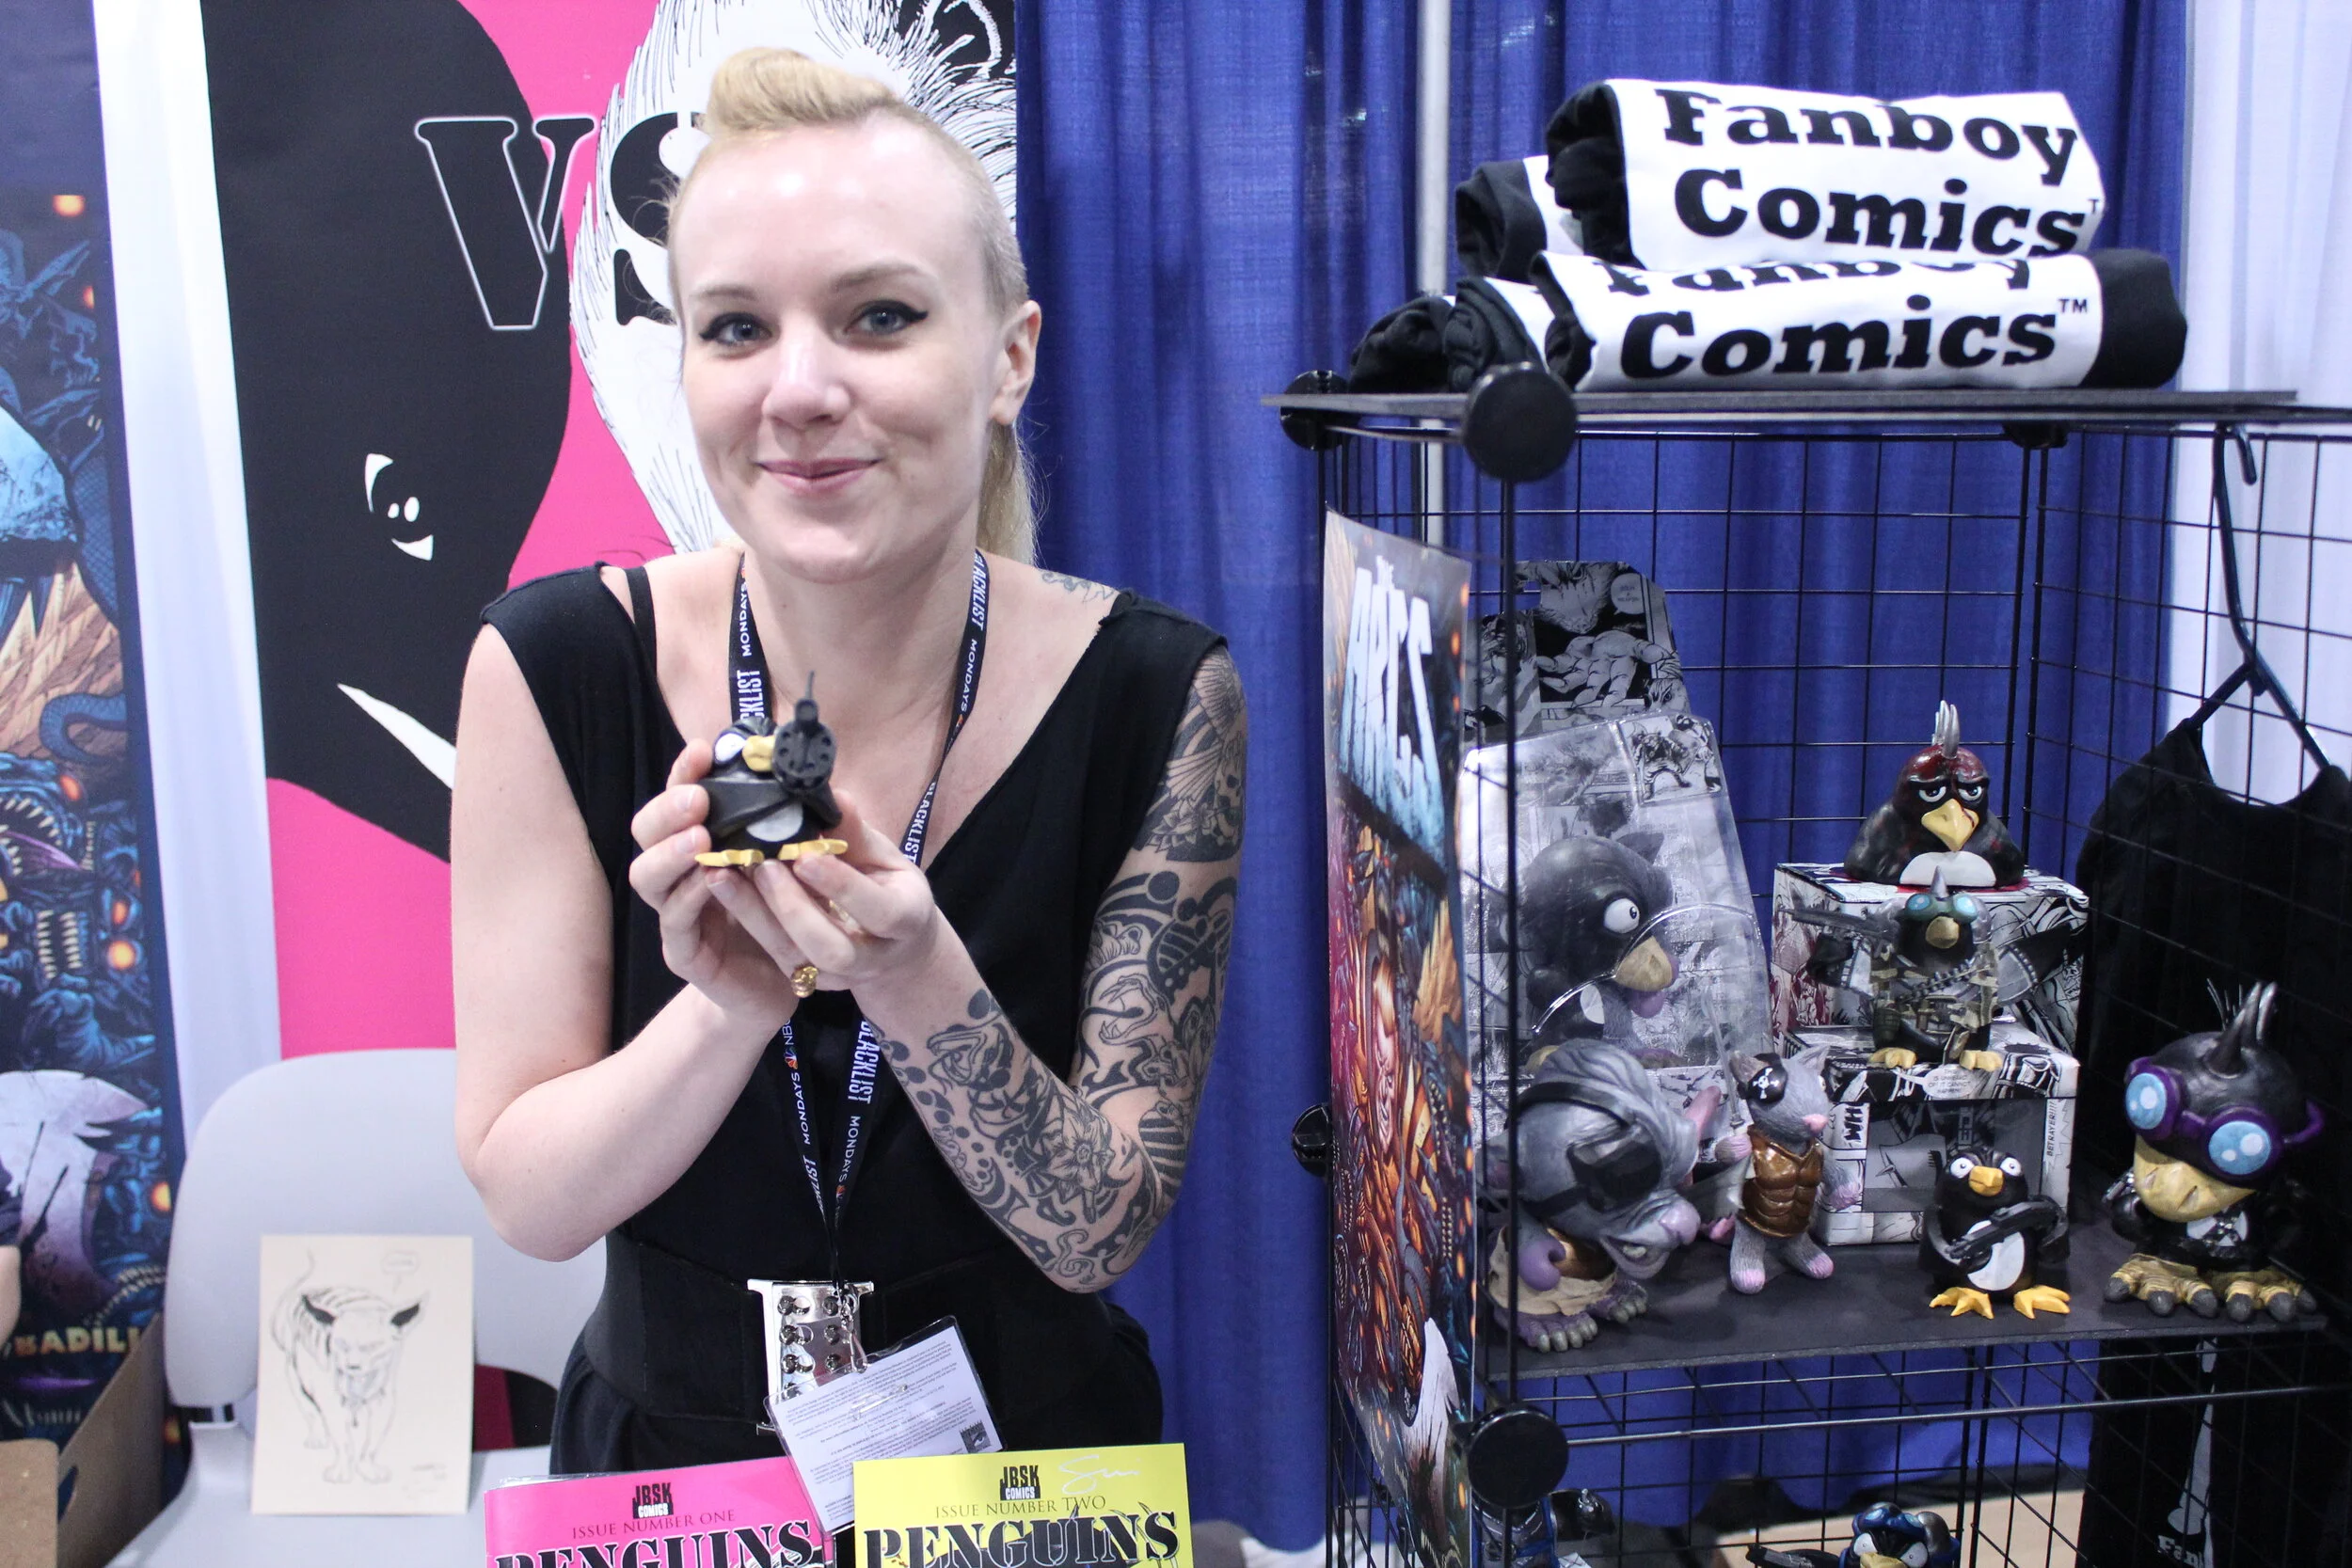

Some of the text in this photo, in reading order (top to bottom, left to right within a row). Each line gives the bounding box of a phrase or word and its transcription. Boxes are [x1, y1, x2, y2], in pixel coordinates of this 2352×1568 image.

[1653, 87, 2078, 187] Fanboy
[1674, 168, 2086, 258] Comics
[1620, 293, 2057, 378] Comics
[739, 580, 753, 657] MONDAYS
[961, 638, 978, 712] MONDAYS
[791, 1071, 811, 1145] MONDAYS
[838, 1116, 862, 1181] MONDAYS
[632, 1481, 673, 1506] JBSK
[999, 1465, 1040, 1487] JBSK
[1005, 1485, 1036, 1500] COMICS
[572, 1509, 736, 1540] ISSUE NUMBER ONE
[637, 1503, 669, 1518] COMICS
[936, 1495, 1107, 1519] ISSUE NUMBER TWO
[864, 1512, 1180, 1568] PENGUINS
